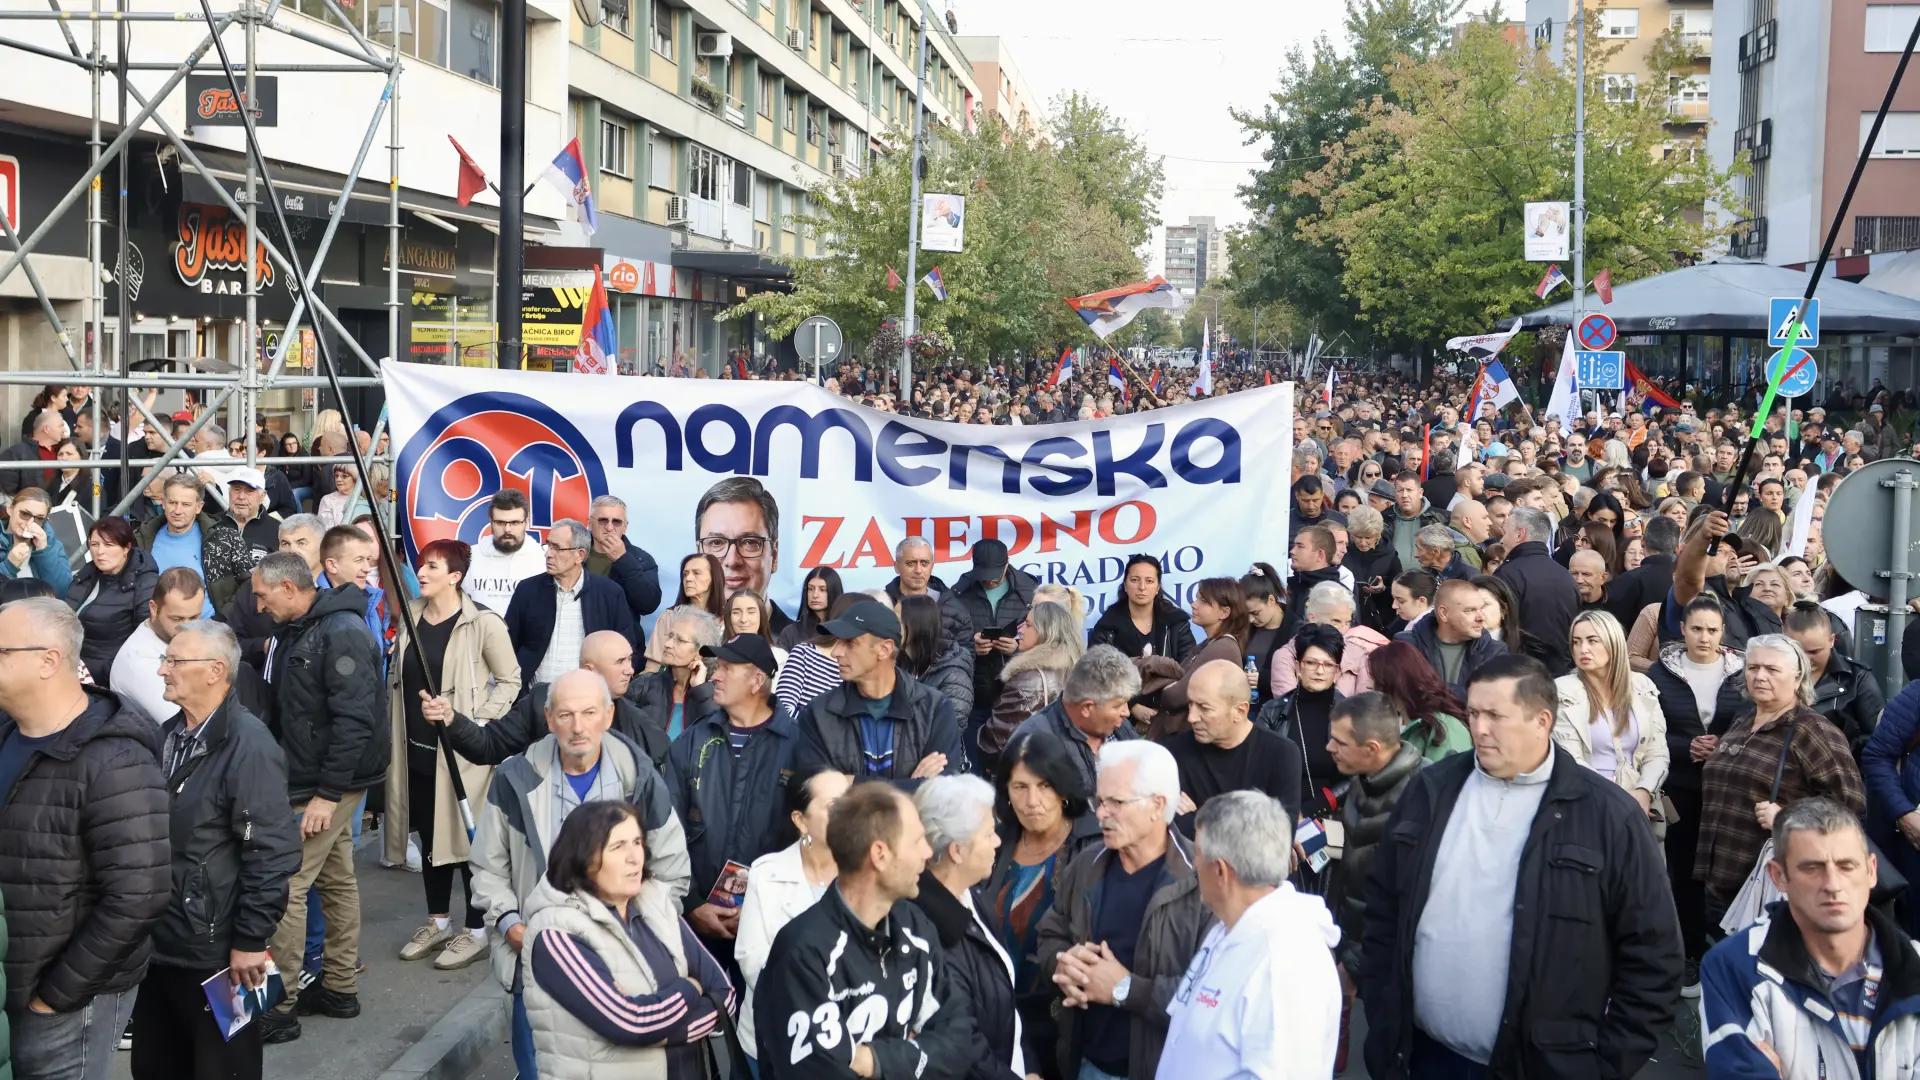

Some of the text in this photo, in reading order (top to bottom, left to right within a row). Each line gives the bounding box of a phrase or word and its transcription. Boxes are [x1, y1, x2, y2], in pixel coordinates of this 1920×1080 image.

[383, 243, 457, 271] AANGARDIA
[612, 266, 636, 282] ria
[201, 279, 243, 295] BAR
[522, 327, 551, 335] AČNICA
[1018, 545, 1204, 586] GRADO
[787, 1001, 842, 1066] 23
